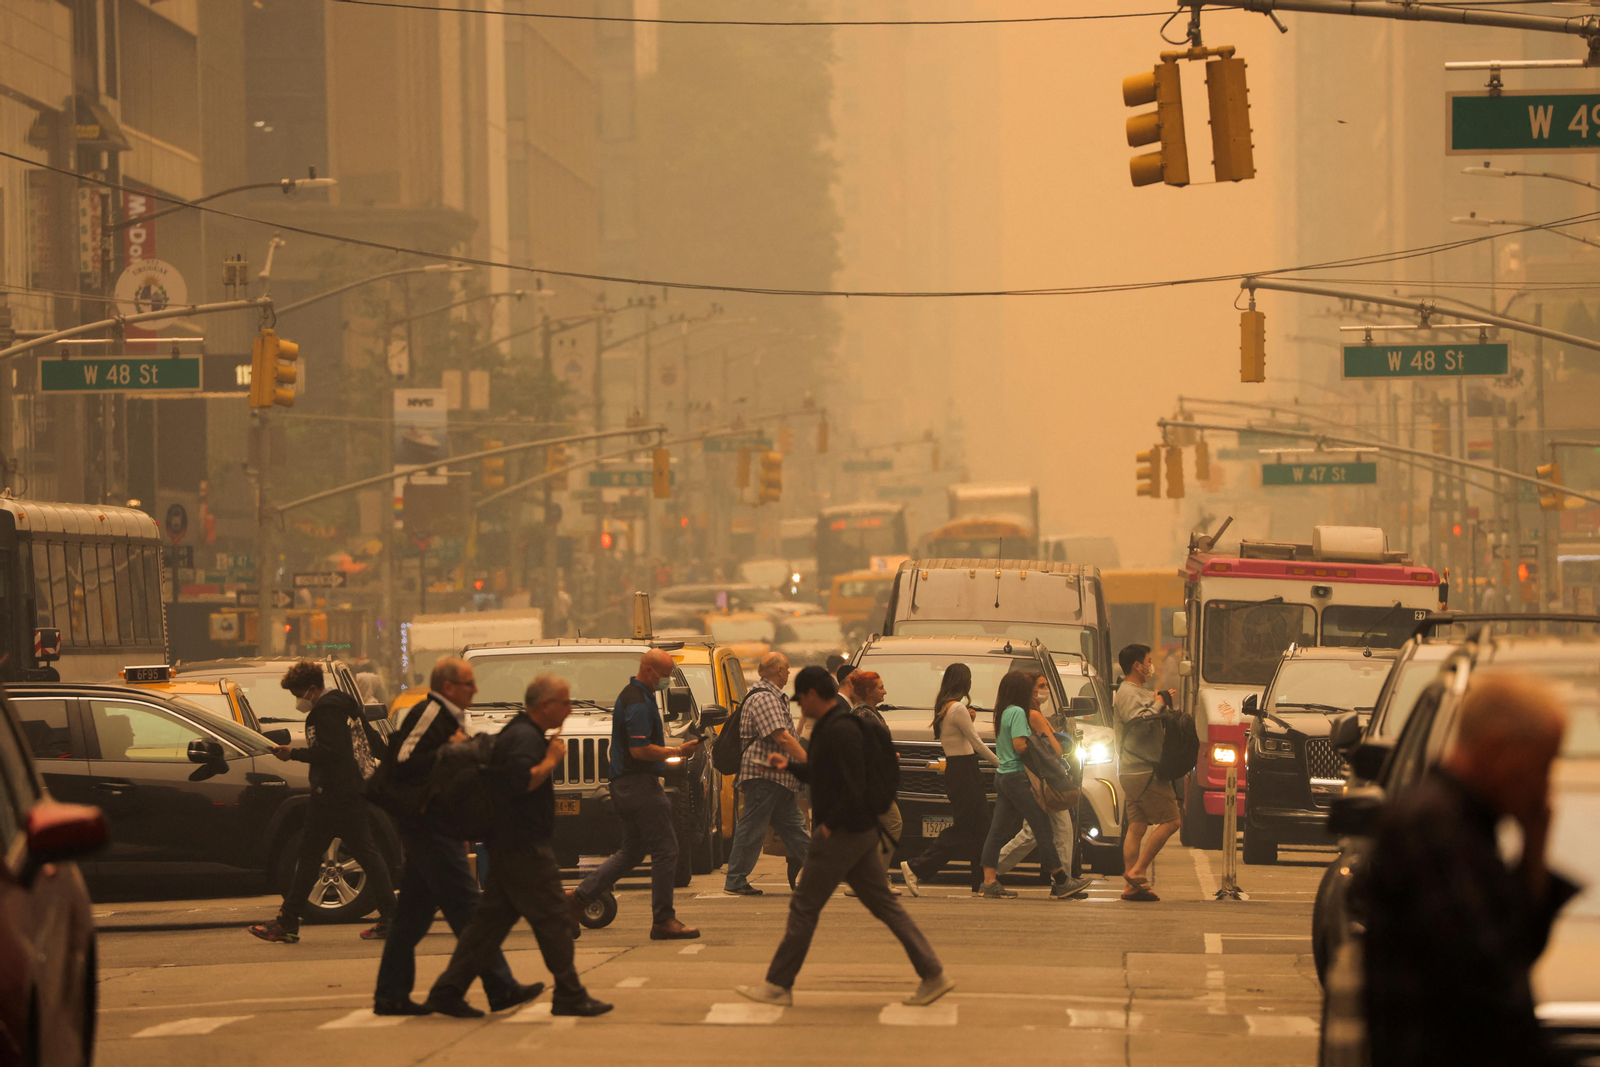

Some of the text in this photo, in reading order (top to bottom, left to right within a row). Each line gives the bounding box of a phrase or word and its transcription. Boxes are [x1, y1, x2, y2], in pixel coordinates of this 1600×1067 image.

[1528, 105, 1554, 139] W
[1387, 349, 1464, 371] W 48 St
[84, 364, 158, 385] W 48 St
[1292, 466, 1346, 482] W 47 St
[1415, 611, 1425, 619] 27
[137, 668, 159, 680] 6F95
